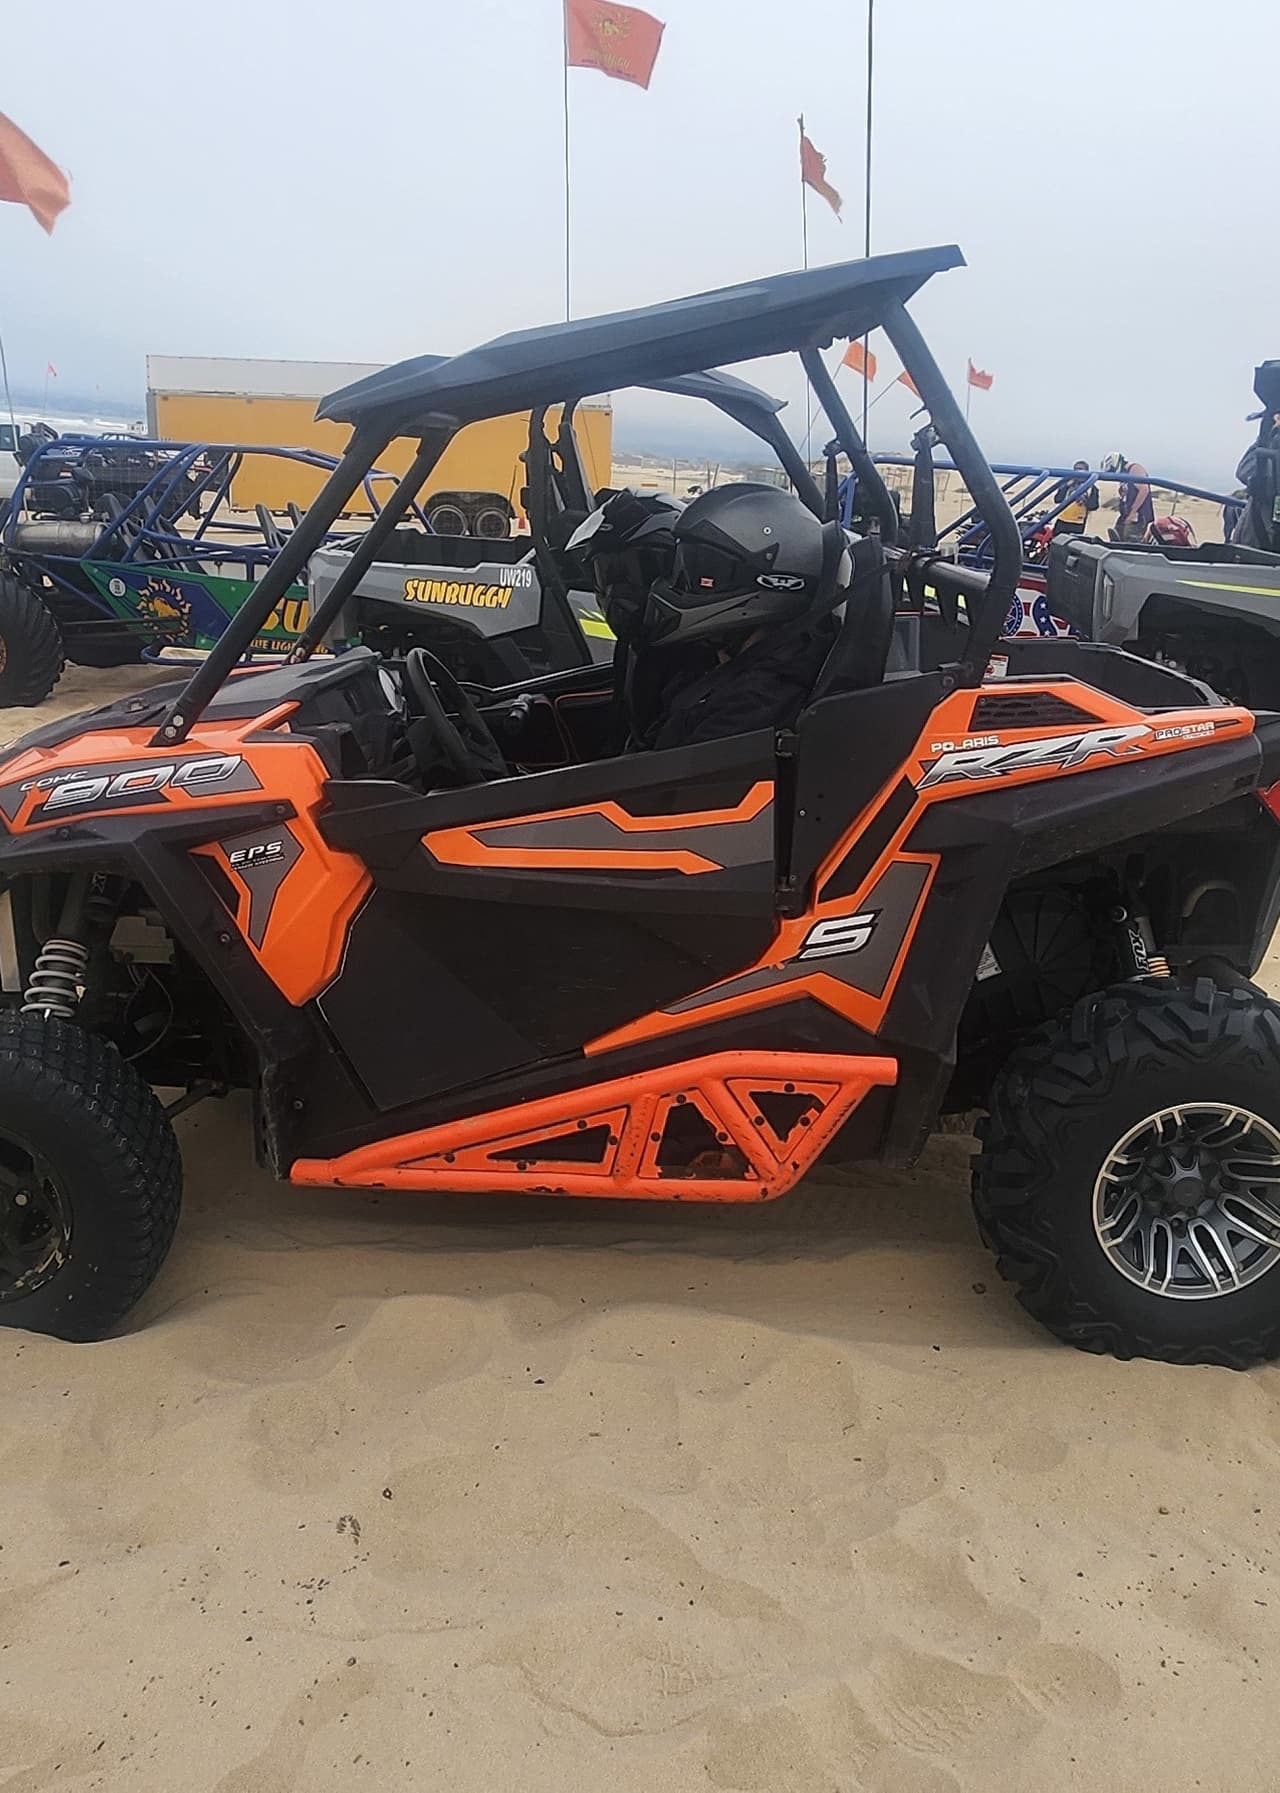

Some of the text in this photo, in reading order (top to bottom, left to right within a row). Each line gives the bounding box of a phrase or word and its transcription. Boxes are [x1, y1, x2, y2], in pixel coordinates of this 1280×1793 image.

[499, 568, 532, 588] UW219
[404, 578, 514, 609] SUNBUGGY
[931, 735, 999, 753] POLARIS
[1155, 721, 1215, 740] PROSTAR
[914, 724, 1152, 790] RZR
[42, 755, 242, 811] 900
[230, 840, 282, 863] EPS
[798, 912, 877, 960] S
